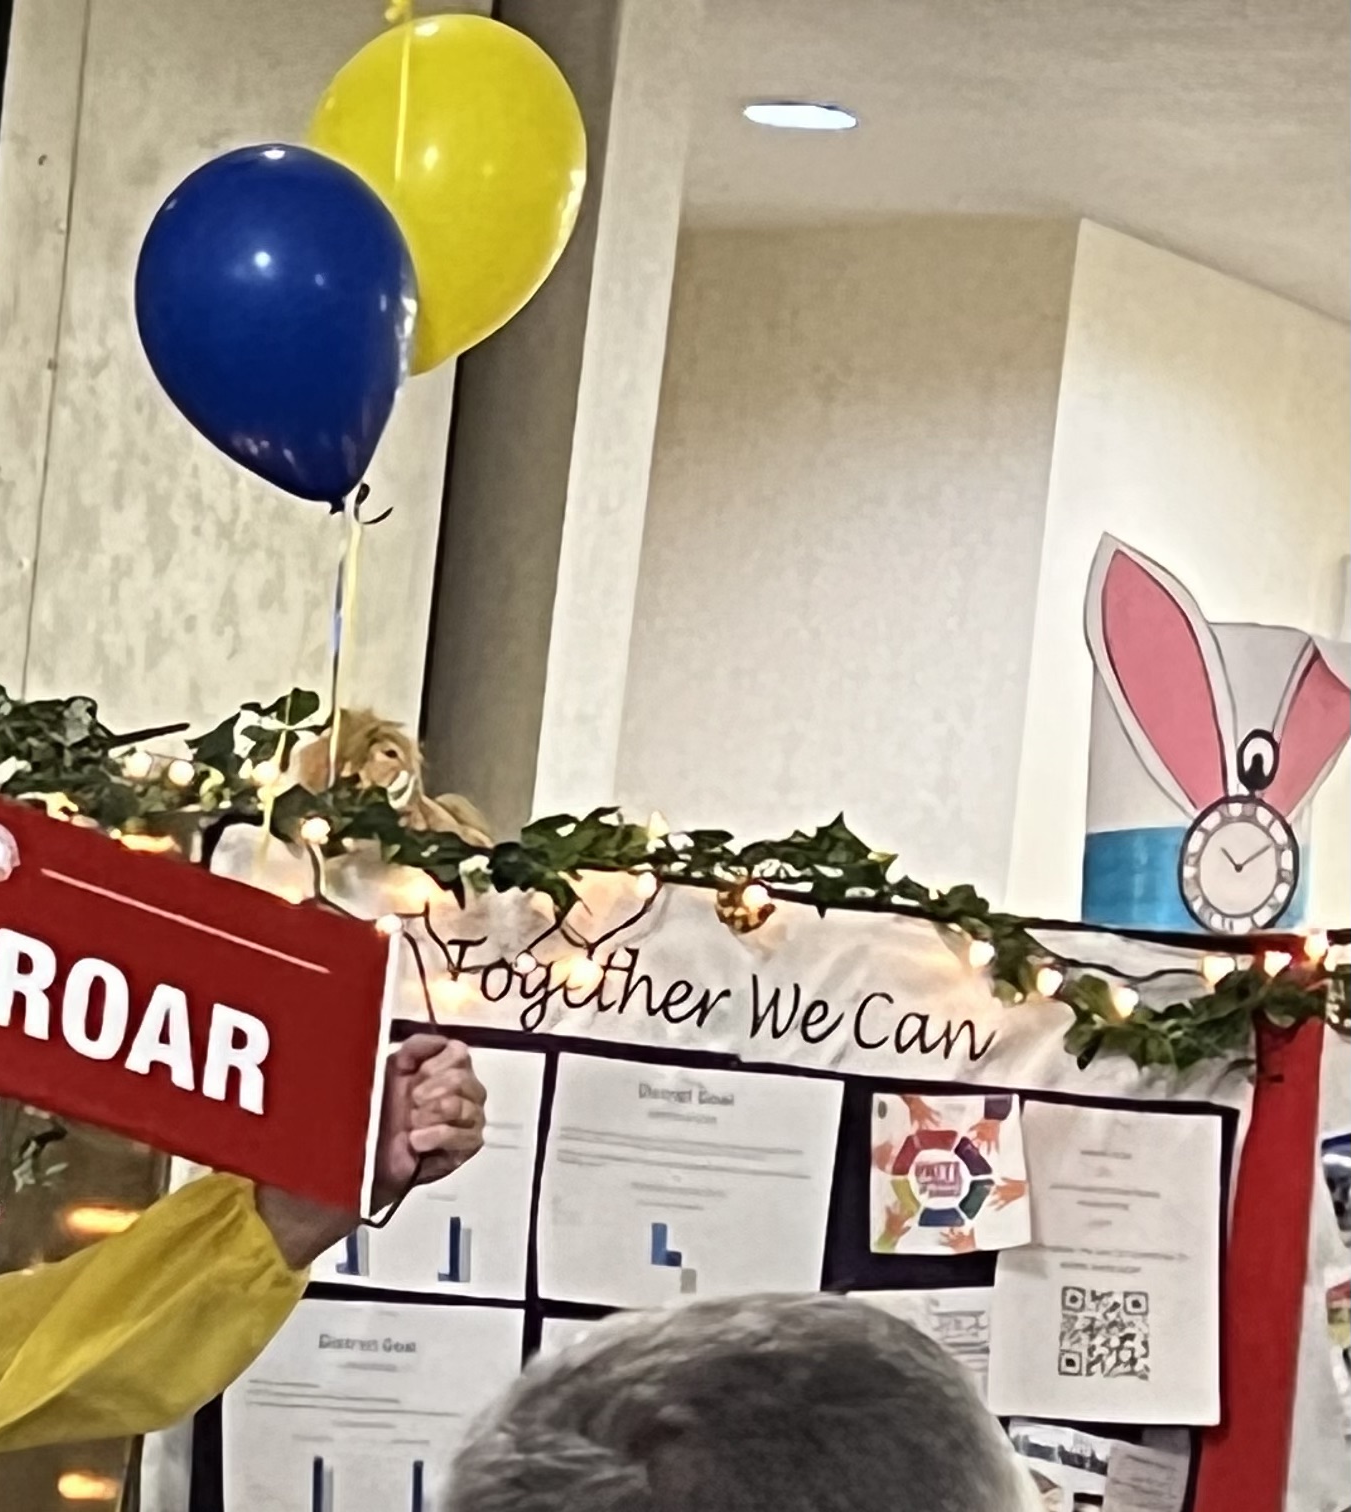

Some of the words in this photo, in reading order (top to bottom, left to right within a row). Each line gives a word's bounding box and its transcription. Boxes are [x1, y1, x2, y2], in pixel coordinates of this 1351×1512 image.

[447, 935, 732, 1033] Together
[750, 973, 846, 1044] We
[854, 991, 997, 1062] Can
